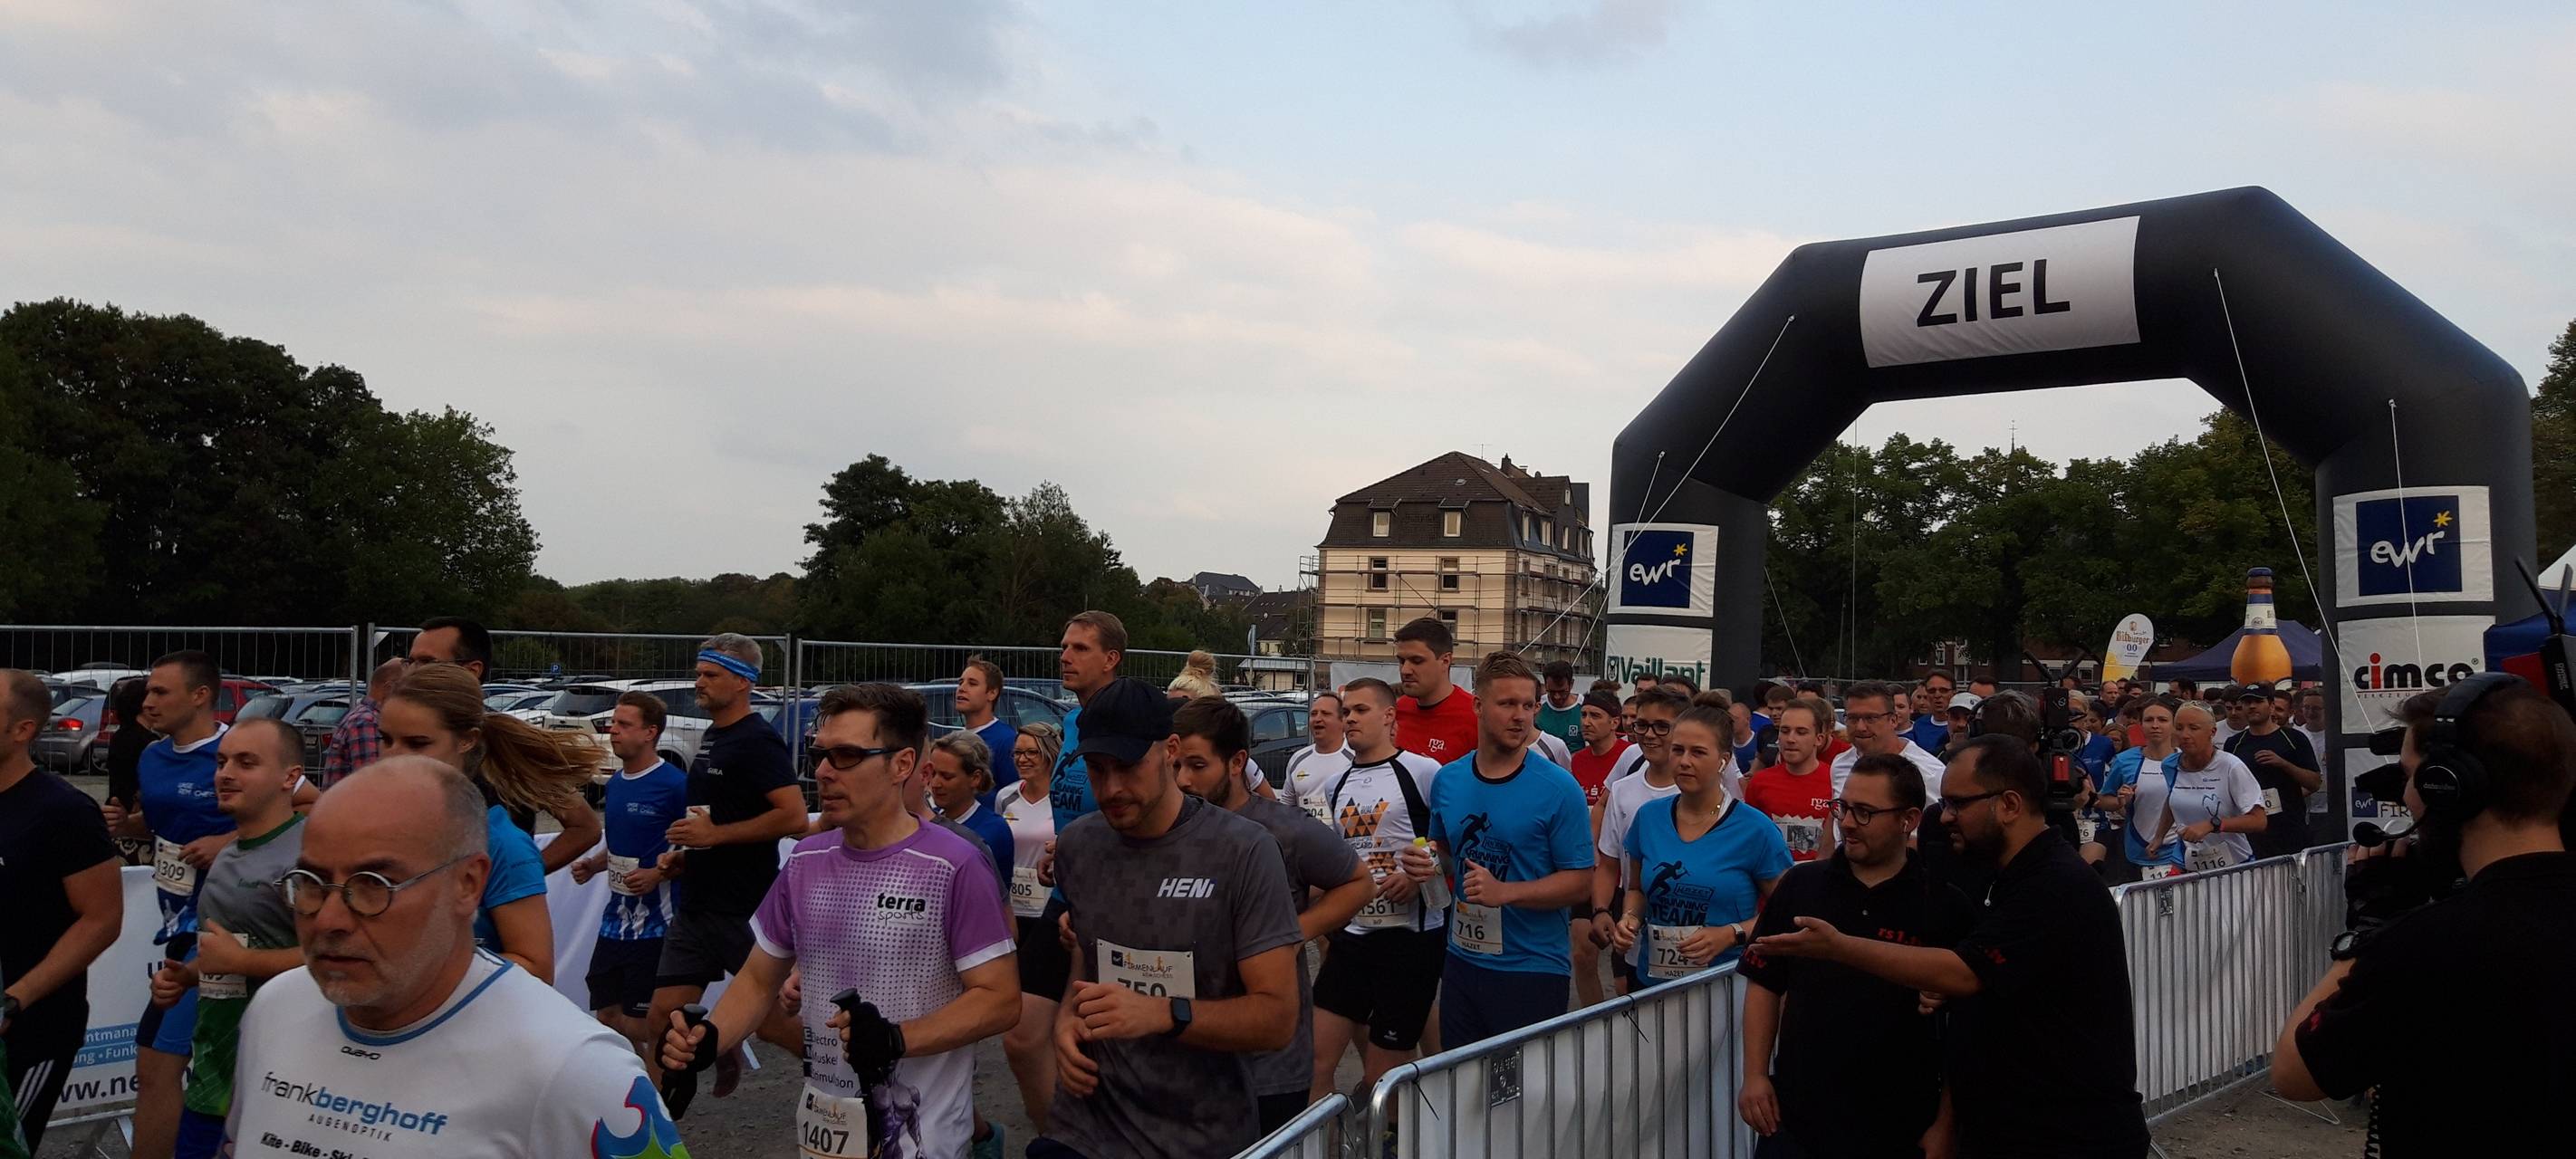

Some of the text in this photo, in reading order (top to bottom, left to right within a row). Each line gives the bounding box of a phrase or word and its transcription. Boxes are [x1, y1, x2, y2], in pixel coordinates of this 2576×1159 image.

[1917, 259, 2070, 327] ZIEL
[2370, 531, 2445, 568] ewr
[1629, 559, 1681, 586] ewr
[2355, 653, 2474, 690] cimco
[2355, 797, 2374, 809] ewr
[878, 893, 926, 912] terra
[1012, 884, 1032, 896] 805
[1648, 903, 1707, 925] TEAM
[1658, 896, 1709, 913] RUNNING
[878, 910, 924, 926] sports
[1457, 920, 1485, 940] 716
[260, 1071, 447, 1135] frankberghoff
[307, 1114, 392, 1142] AUGENOPTIK
[803, 1121, 850, 1154] 1407
[260, 1132, 283, 1149] Kite
[291, 1139, 321, 1158] Bike
